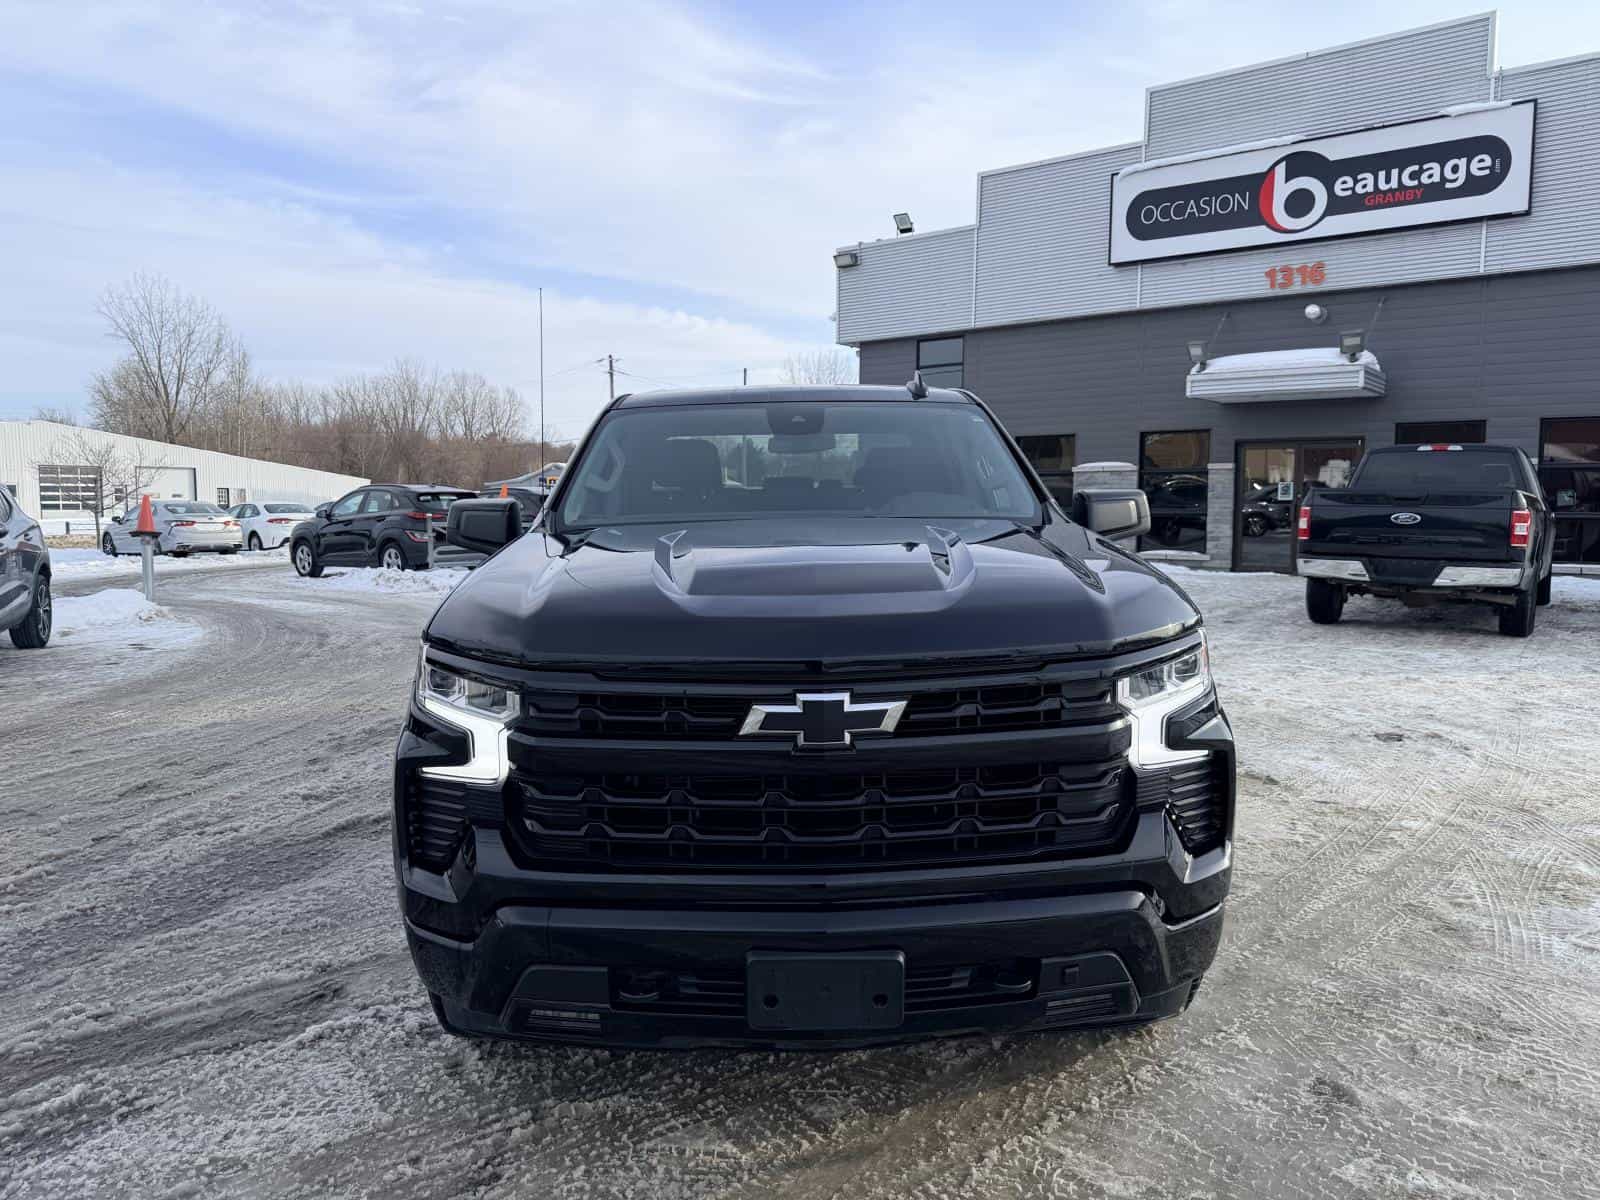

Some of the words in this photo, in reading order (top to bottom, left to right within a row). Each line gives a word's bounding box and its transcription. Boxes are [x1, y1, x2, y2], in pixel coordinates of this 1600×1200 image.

[1140, 191, 1249, 225] OCCASION
[1364, 188, 1424, 206] GRANBY
[1264, 261, 1328, 289] 1316
